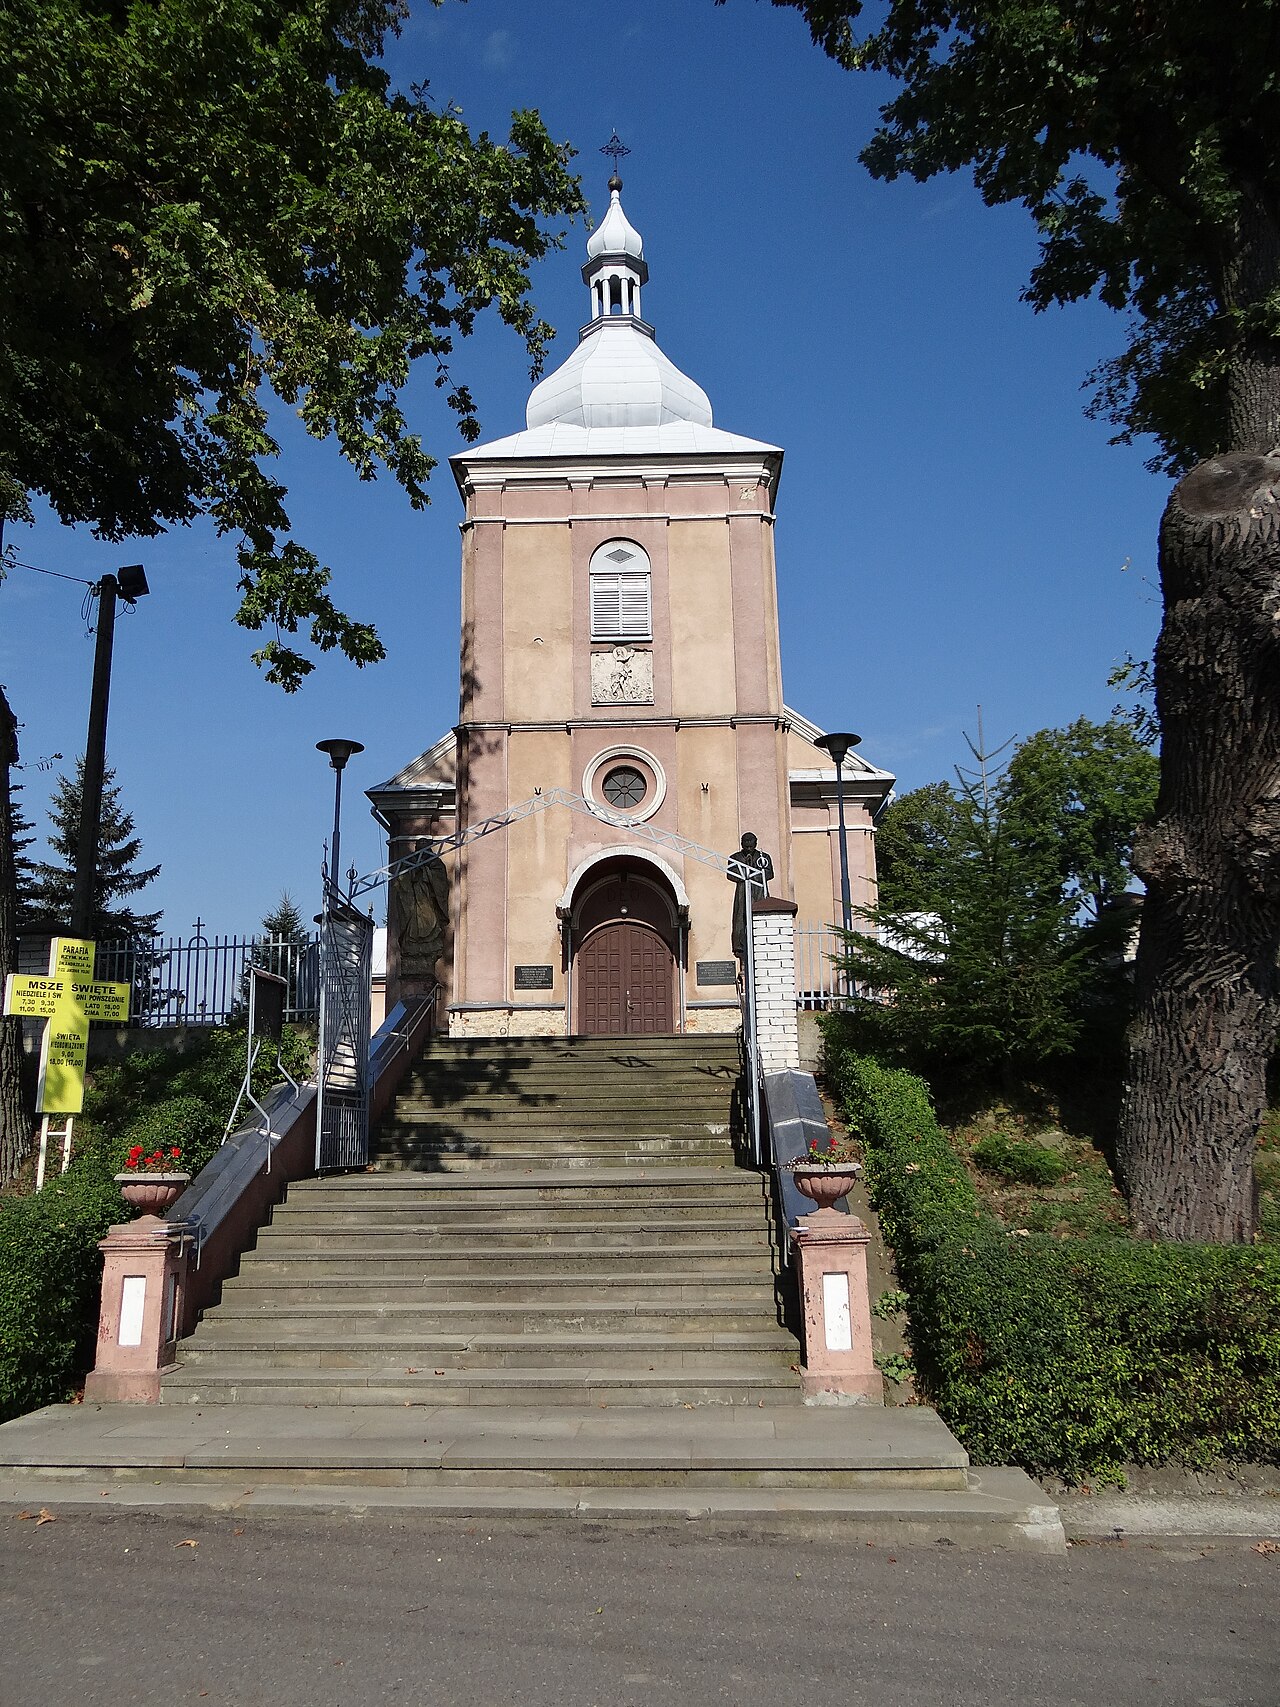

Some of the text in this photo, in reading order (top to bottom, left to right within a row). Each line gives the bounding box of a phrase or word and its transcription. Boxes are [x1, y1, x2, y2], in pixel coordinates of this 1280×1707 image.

[63, 946, 89, 955] PARAFIA
[28, 981, 116, 995] MSZE ŚWIĘTE
[16, 990, 46, 998] NIEDZIELE
[89, 995, 125, 1003] POWSZEDNIE
[56, 1032, 80, 1041] ŚWIĘTA
